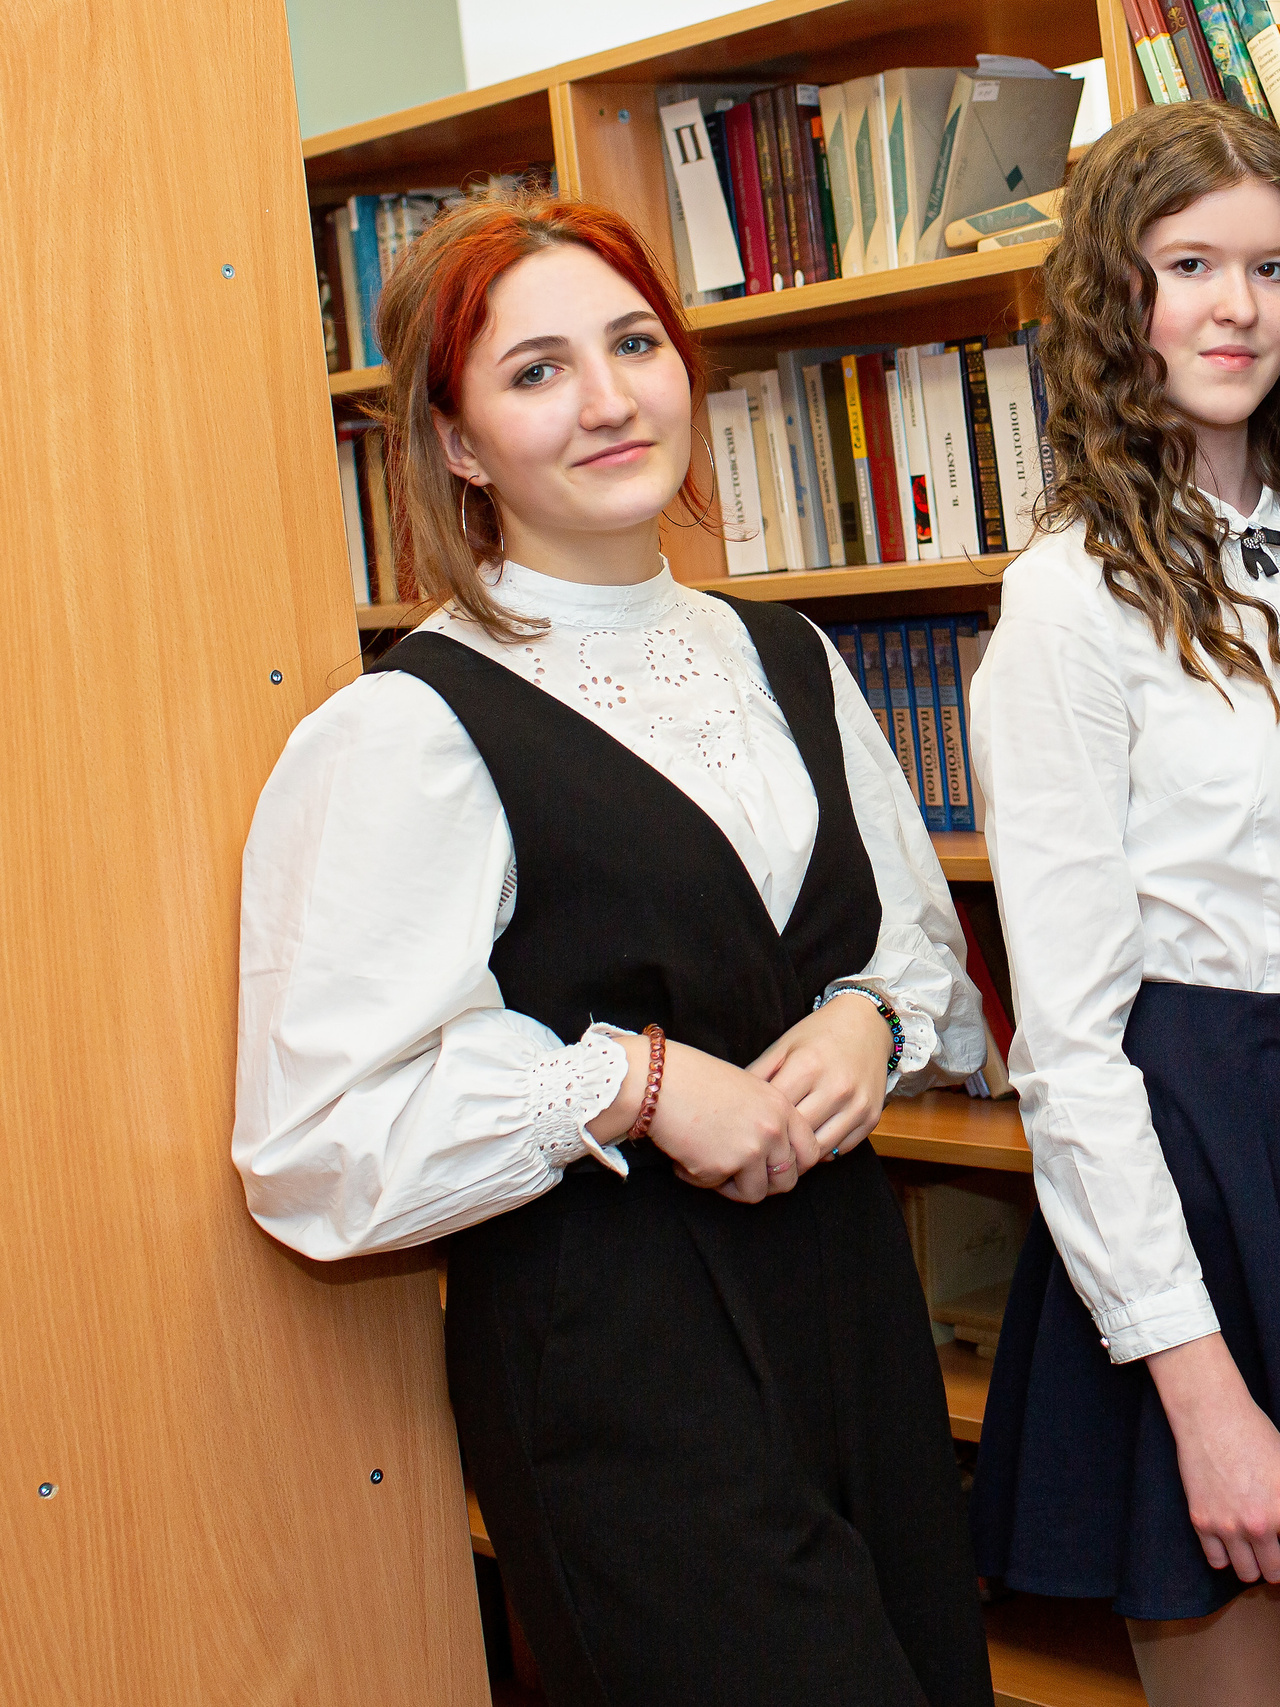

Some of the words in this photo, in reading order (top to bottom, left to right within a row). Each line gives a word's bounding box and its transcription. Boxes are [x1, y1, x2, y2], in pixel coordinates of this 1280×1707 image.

[674, 124, 706, 165] П
[724, 426, 746, 525] ПАУСТОВСКИЙ
[944, 432, 958, 489] ПИКУЛЬ
[1009, 401, 1026, 481] ПЛАТОНОВ
[951, 495, 960, 507] В.
[920, 710, 936, 803] ПЛАТОНОВ
[943, 709, 961, 803] ПЛАТОНОВ
